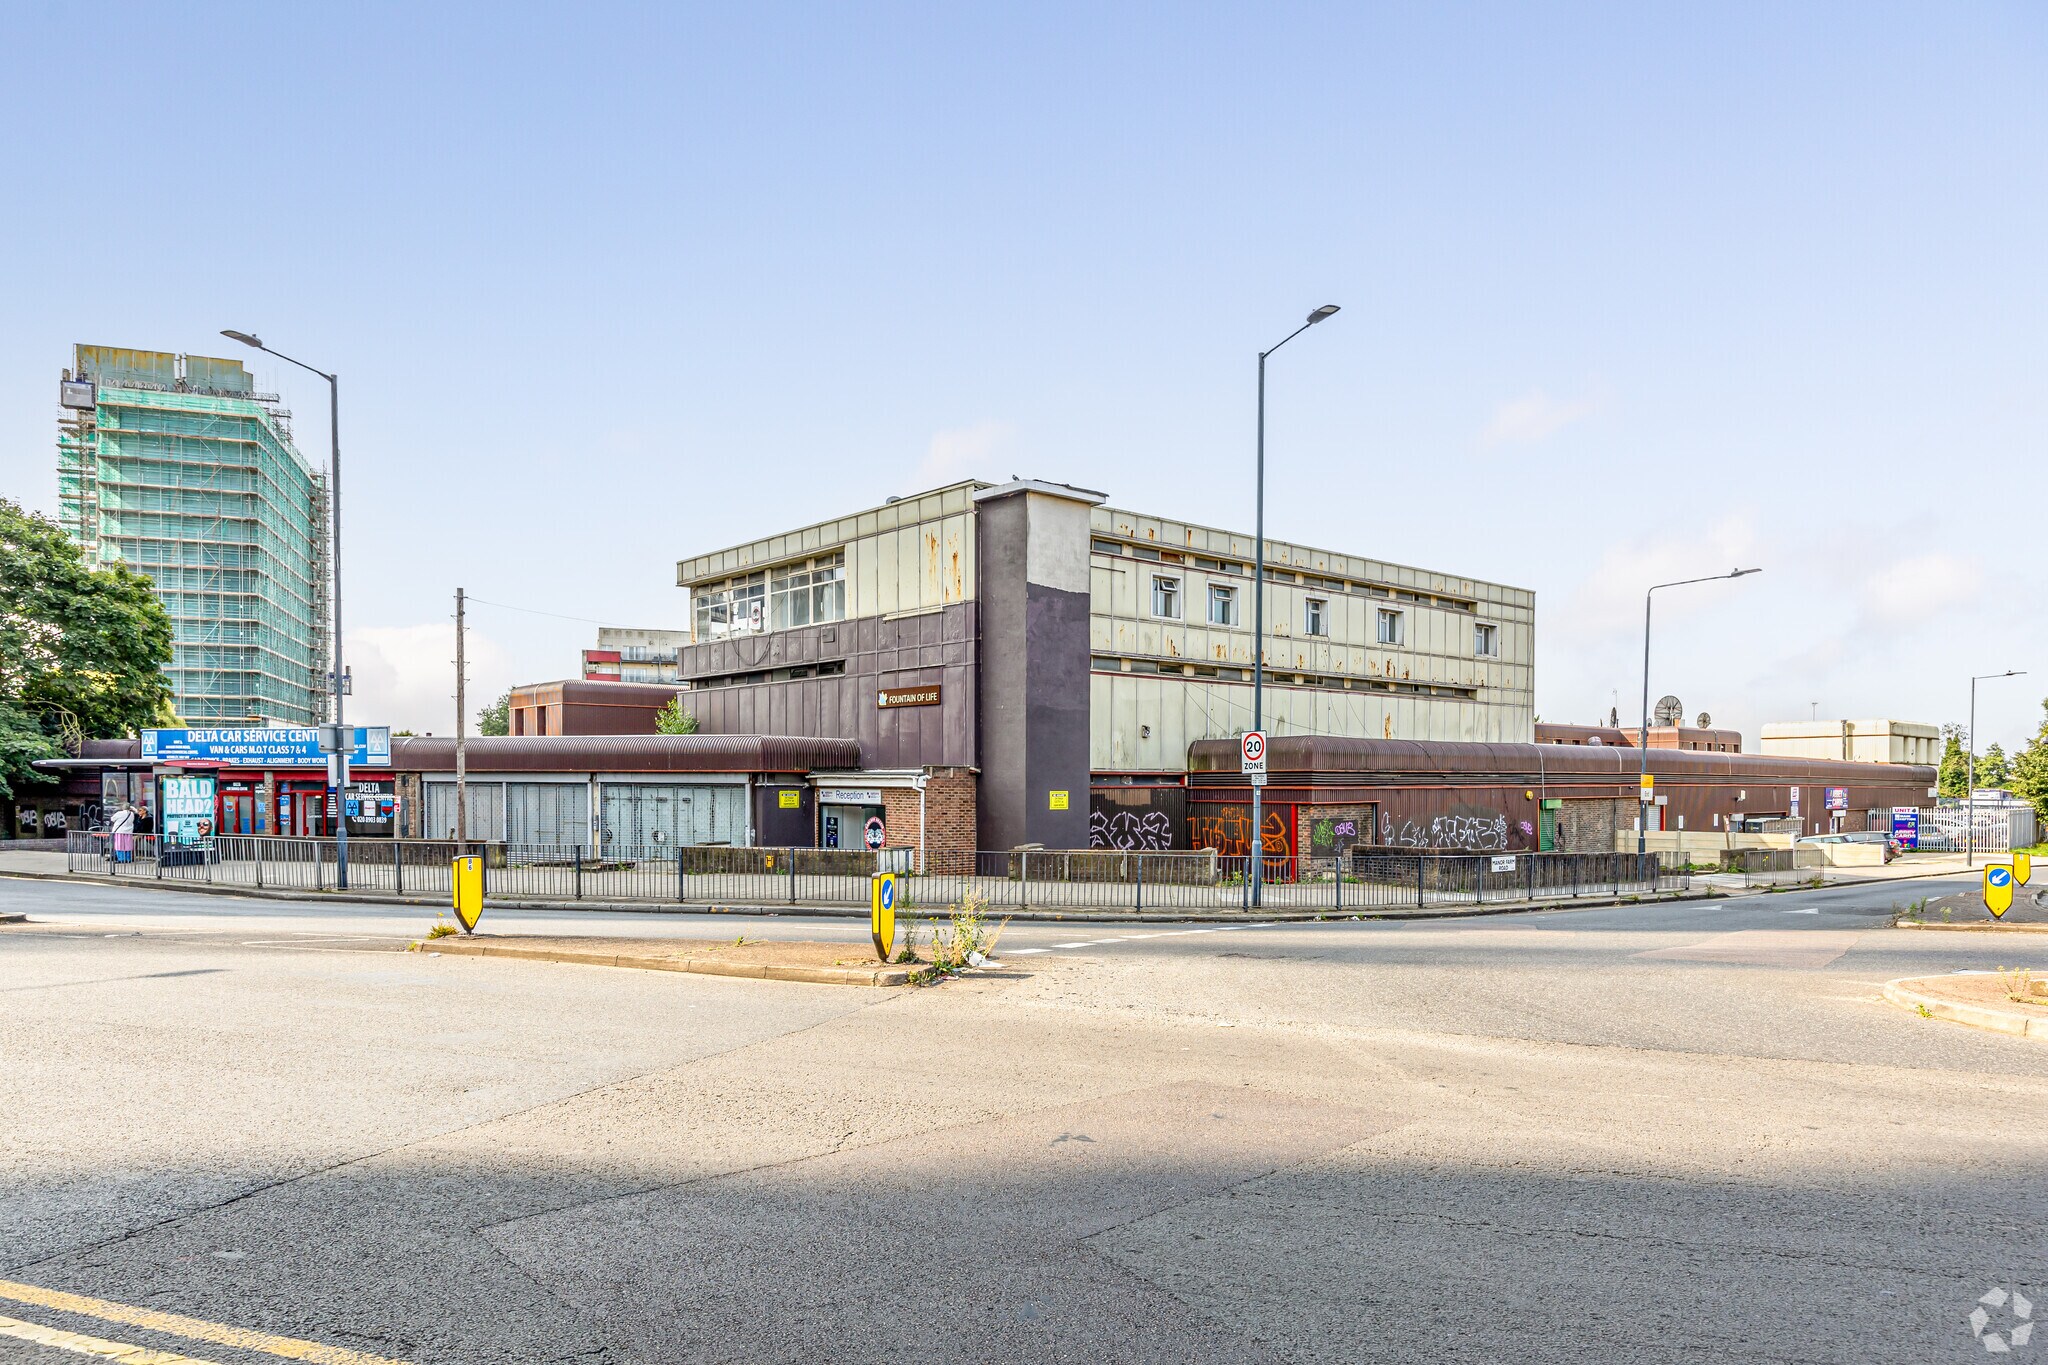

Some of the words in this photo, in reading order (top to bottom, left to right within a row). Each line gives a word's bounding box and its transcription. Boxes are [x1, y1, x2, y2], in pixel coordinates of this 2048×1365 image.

[889, 694, 916, 704] FOUNTAIN
[917, 693, 925, 702] OF
[925, 692, 938, 701] LIFE
[187, 730, 220, 743] DELTA
[220, 730, 242, 743] CAR
[243, 730, 287, 743] SERVICE
[288, 730, 319, 742] CENT
[209, 745, 224, 754] VAN
[224, 745, 230, 754] &
[230, 745, 248, 754] CARS
[248, 745, 267, 754] M.O.T
[268, 745, 289, 754] CLASS
[290, 745, 295, 754] 7
[295, 745, 301, 754] &
[301, 745, 307, 754] 4
[1246, 740, 1261, 753] 20
[1244, 762, 1264, 770] ZONE
[166, 780, 212, 799] BALD
[358, 782, 380, 794] DELTA
[835, 790, 864, 801] Reception
[166, 798, 212, 814] HEAD?
